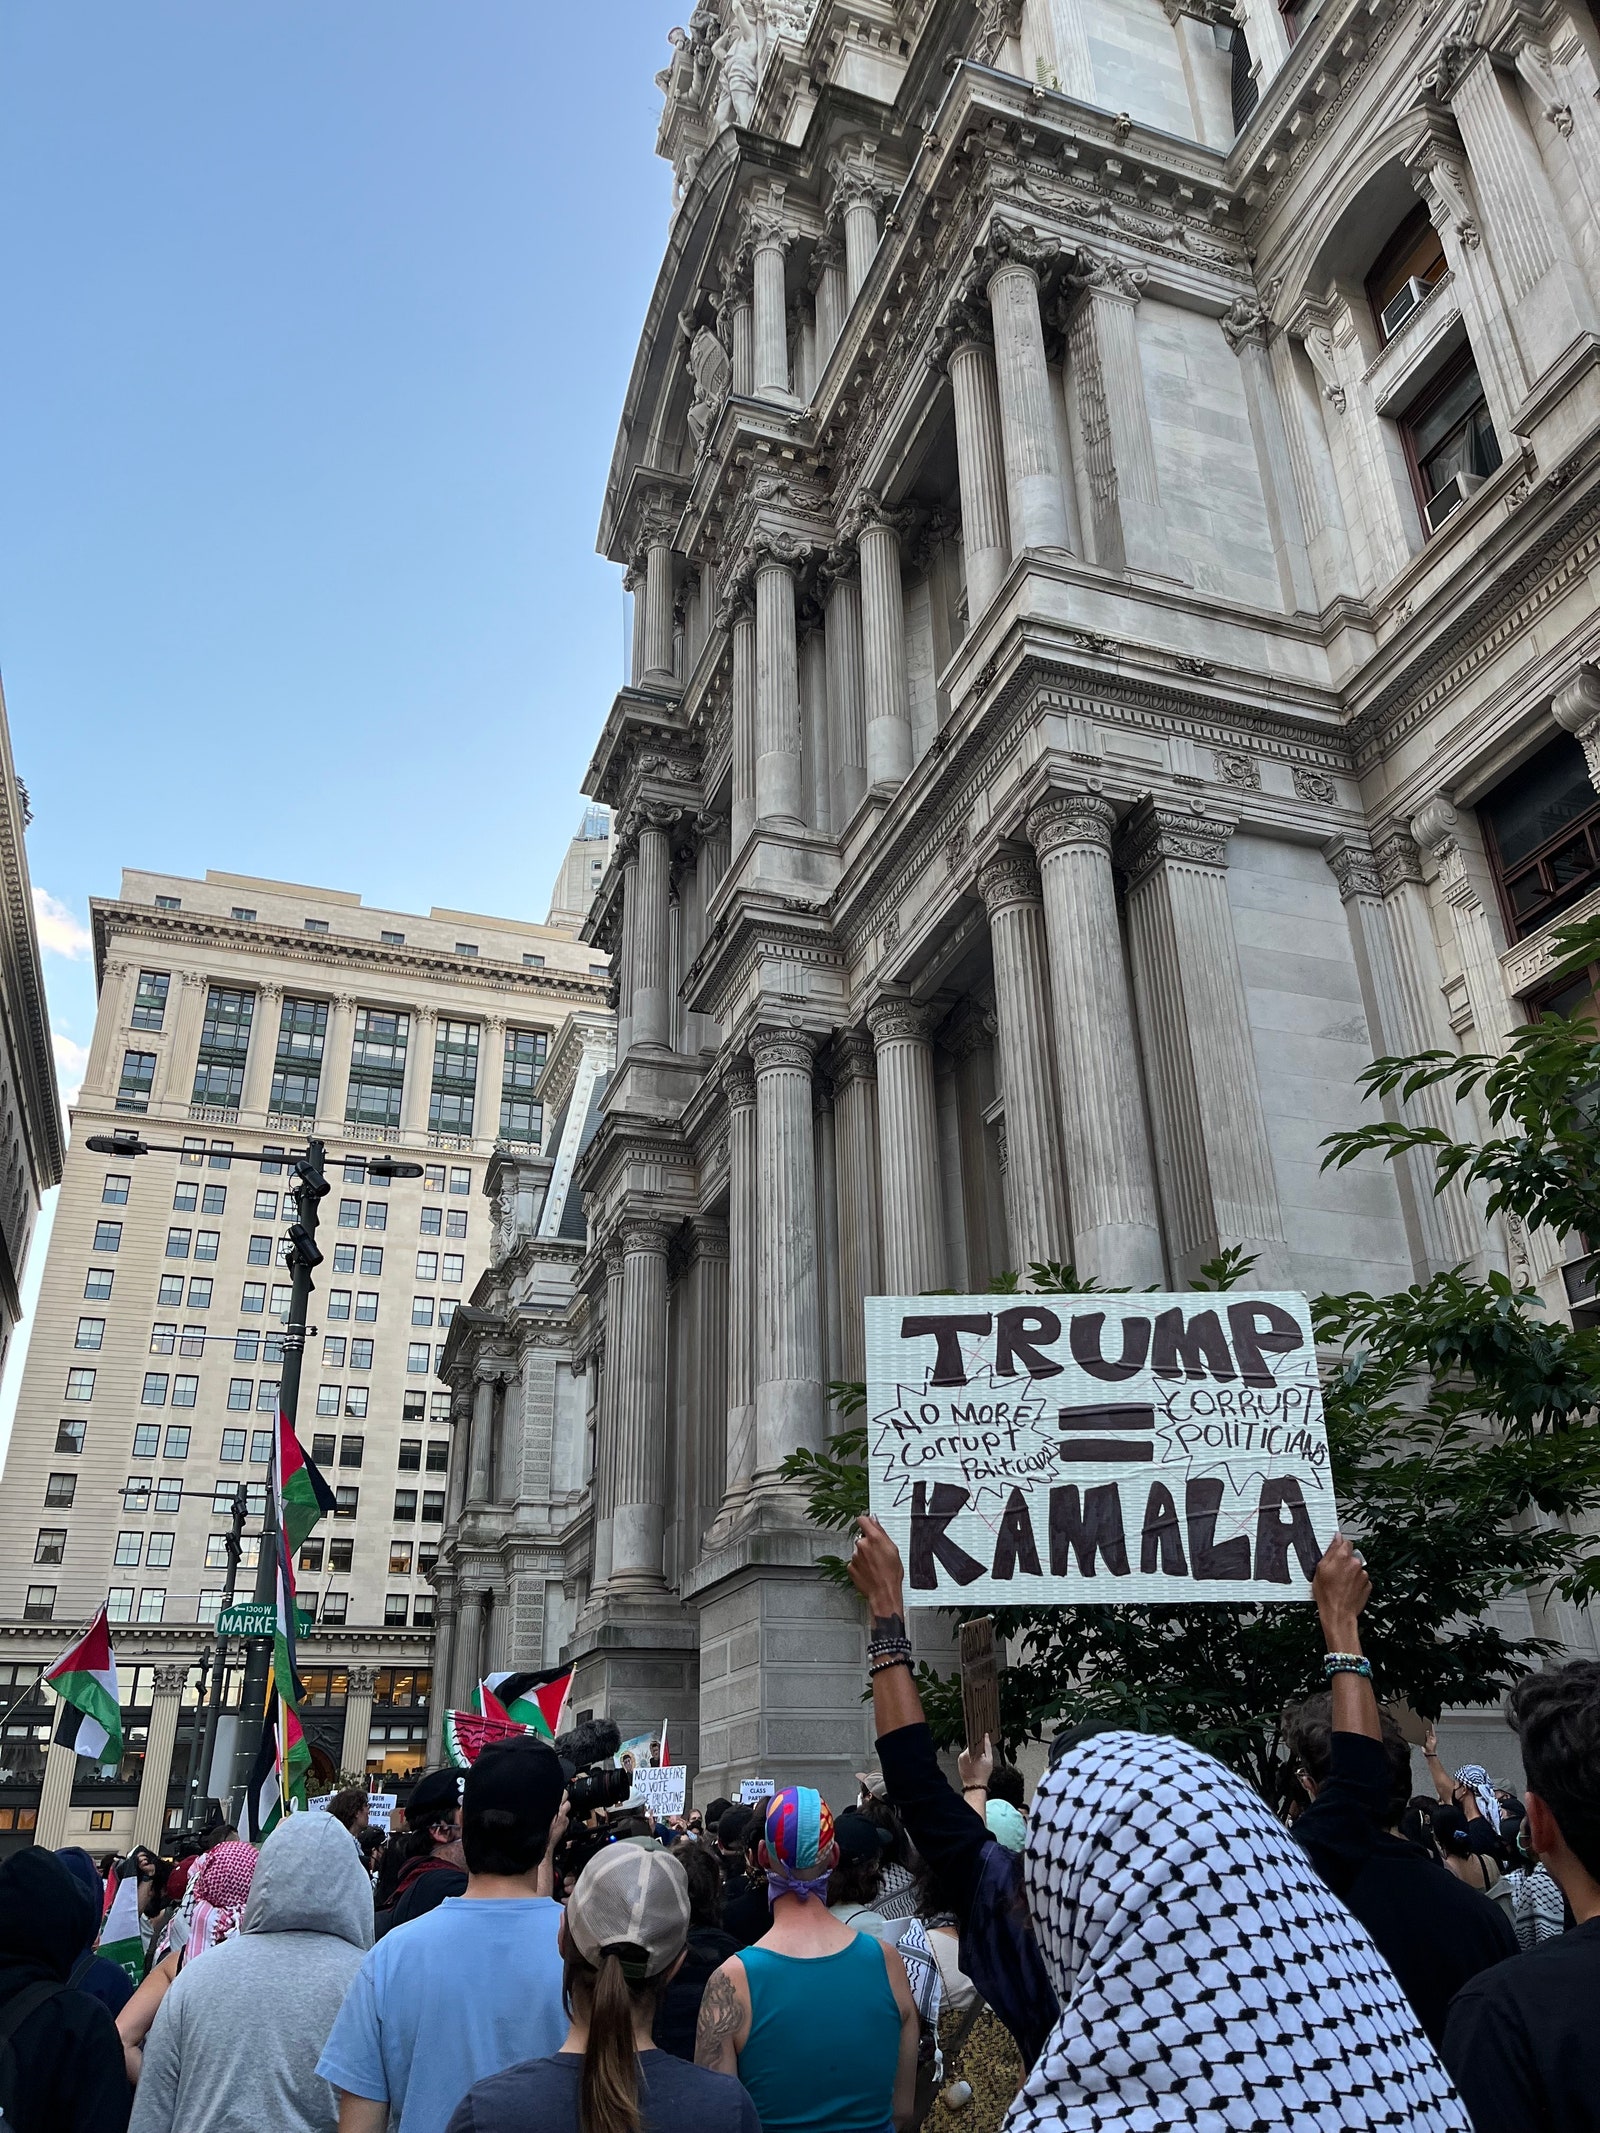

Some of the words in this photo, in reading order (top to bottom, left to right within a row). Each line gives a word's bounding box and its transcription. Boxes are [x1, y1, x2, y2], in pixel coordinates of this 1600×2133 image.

[900, 1300, 1304, 1388] TRUMP
[1166, 1383, 1321, 1426] CORRUPT
[890, 1403, 940, 1440] NO
[950, 1402, 1033, 1427] MORE
[908, 1477, 1324, 1590] KAMALA
[220, 1614, 278, 1633] MARKE
[264, 1606, 272, 1615] W
[634, 1769, 646, 1781] NO
[648, 1767, 685, 1780] CEASEFIRE
[634, 1783, 646, 1793] NO
[649, 1780, 669, 1793] VOTE
